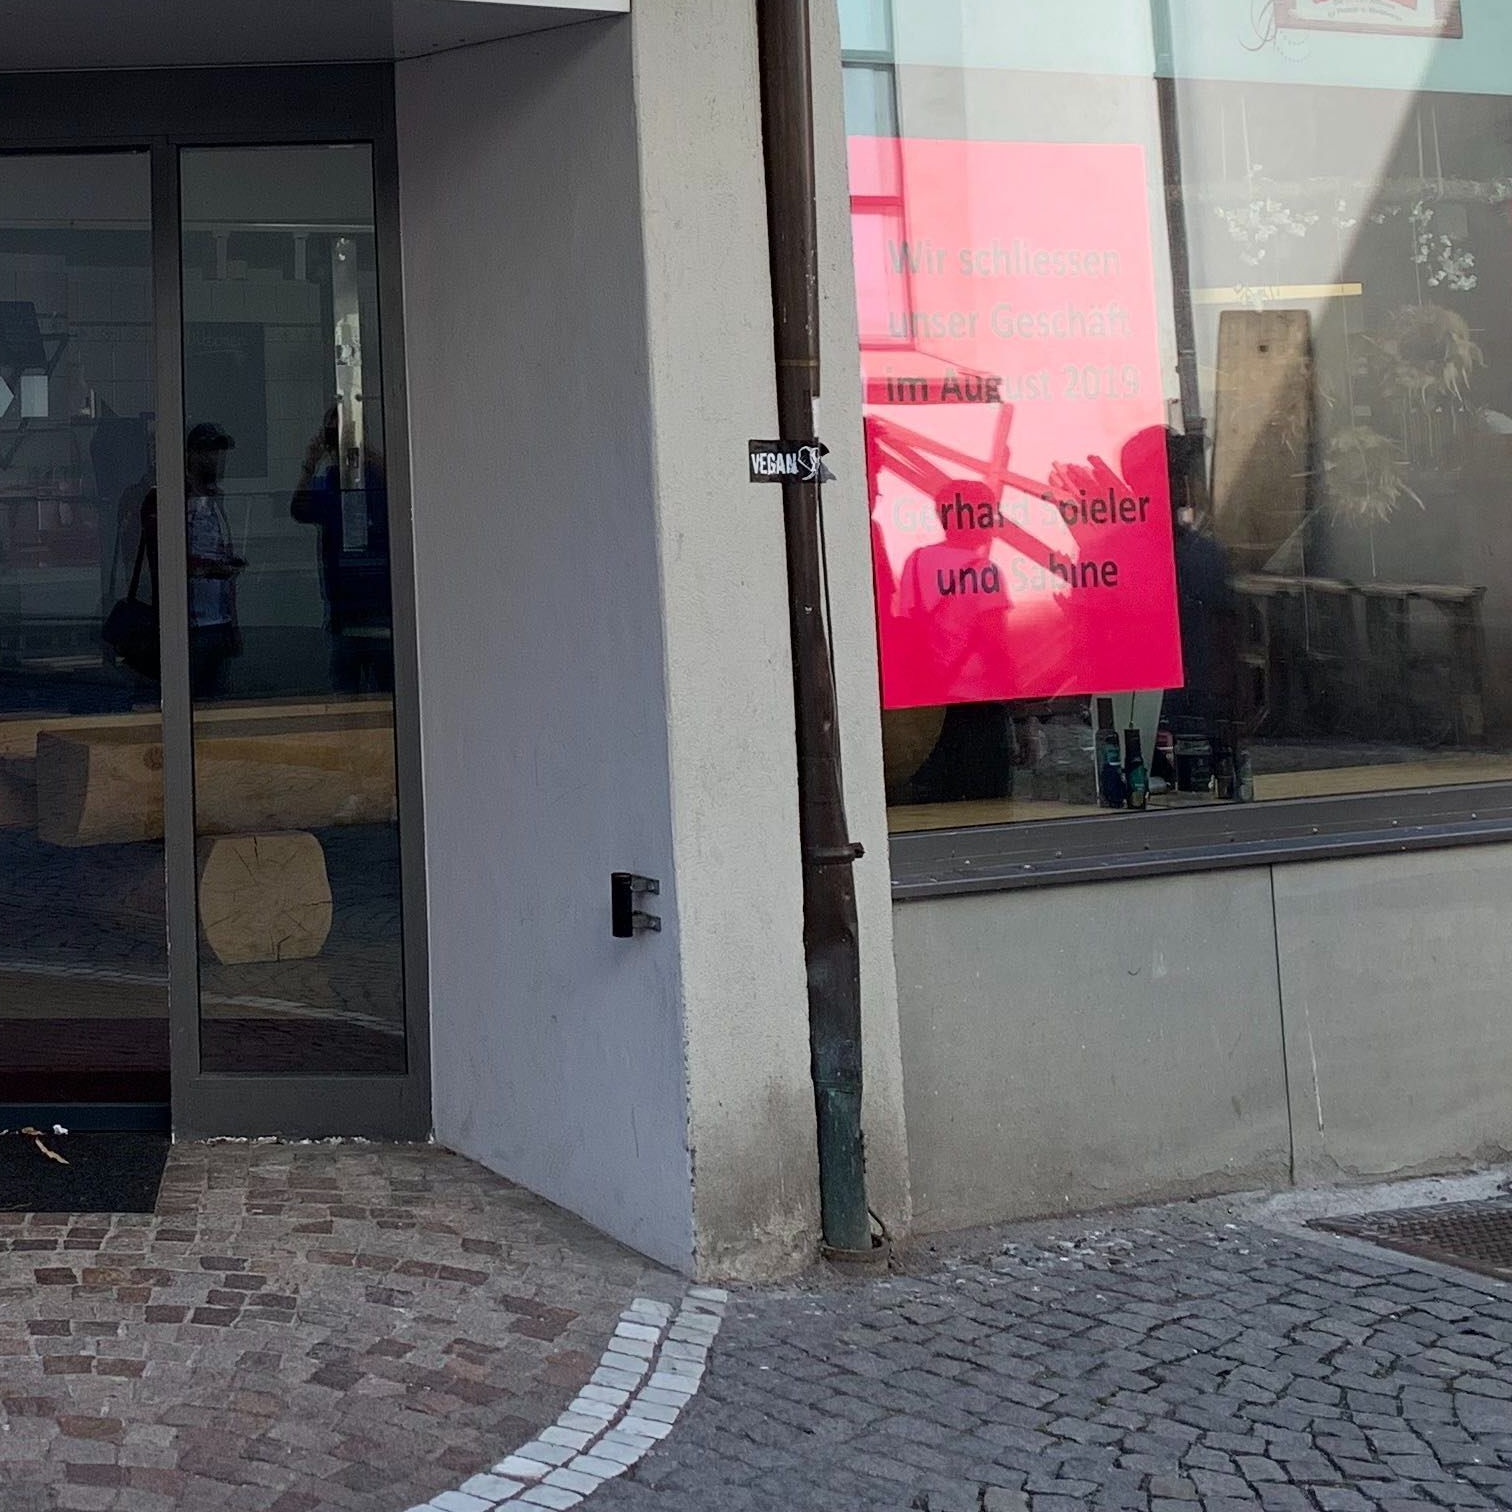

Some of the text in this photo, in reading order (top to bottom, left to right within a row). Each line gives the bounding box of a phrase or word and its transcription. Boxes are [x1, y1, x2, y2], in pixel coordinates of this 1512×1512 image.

[887, 239, 1121, 279] Wir schliessen
[888, 301, 1132, 340] unser Geschäft
[886, 365, 1140, 404] im August 2019
[750, 452, 799, 476] VEGAN
[892, 491, 1150, 534] Gerhard Spieler
[936, 552, 1119, 597] und Sabine
